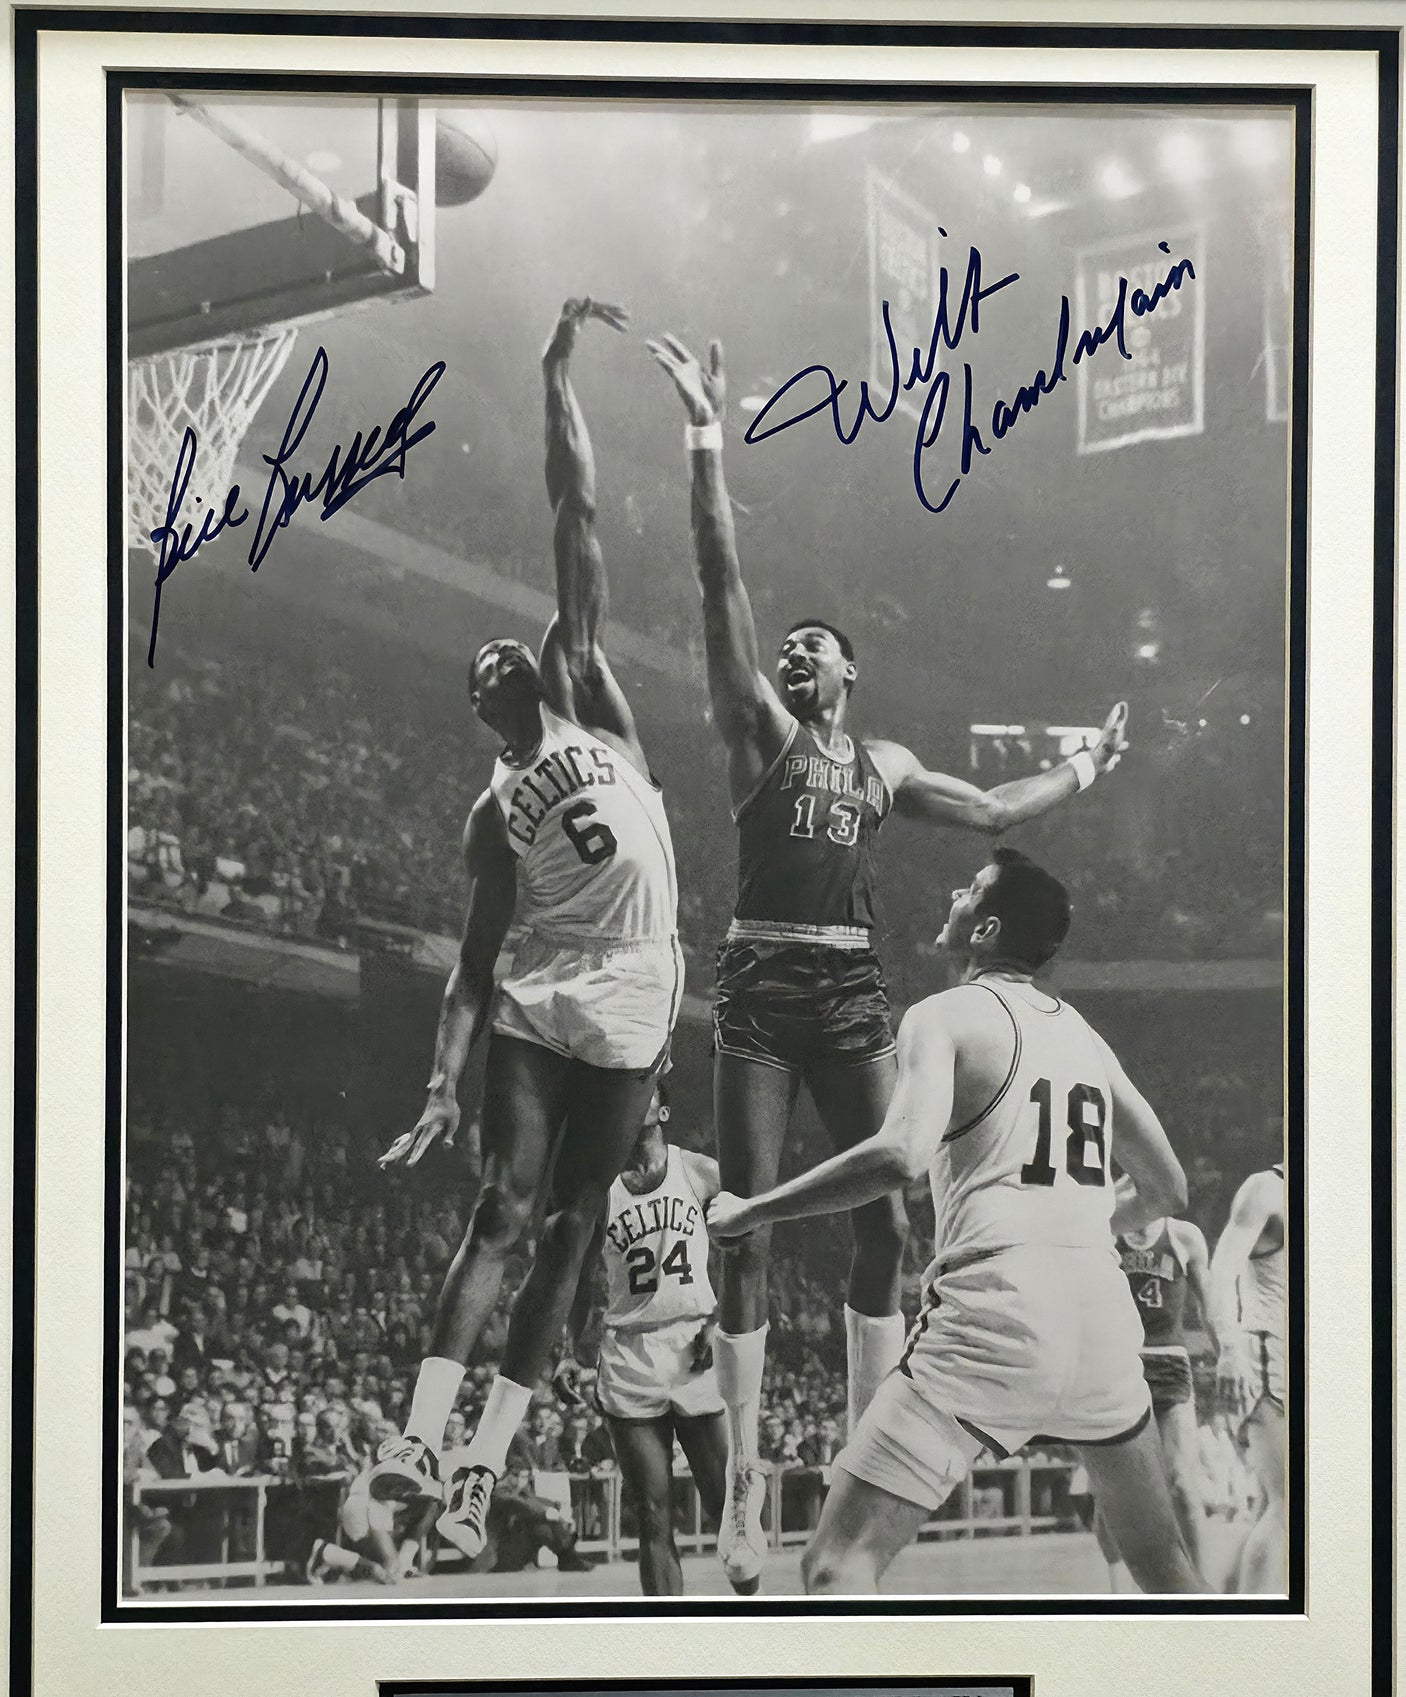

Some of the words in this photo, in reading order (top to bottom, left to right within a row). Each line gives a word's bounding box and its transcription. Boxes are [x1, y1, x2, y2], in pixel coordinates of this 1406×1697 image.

[742, 226, 1020, 445] Wilt
[507, 745, 616, 848] CELTICS
[780, 755, 884, 818] PHILA
[561, 800, 618, 865] 6
[789, 794, 862, 846] 13
[1020, 1077, 1106, 1187] 18
[606, 1195, 699, 1254] CELTICS
[625, 1239, 694, 1296] 24
